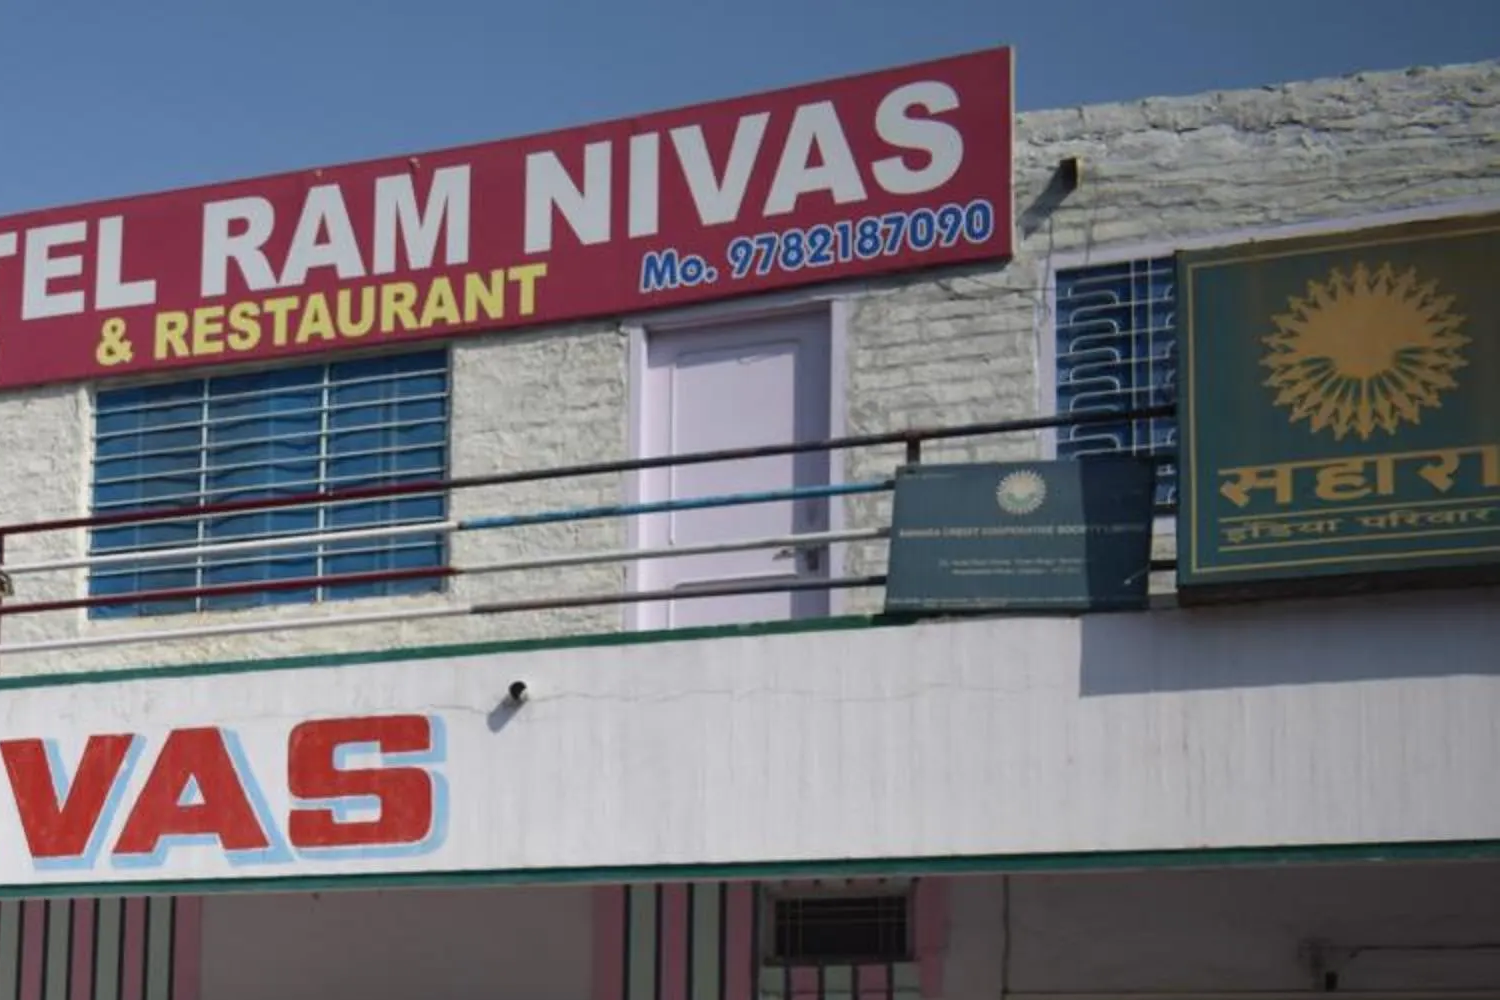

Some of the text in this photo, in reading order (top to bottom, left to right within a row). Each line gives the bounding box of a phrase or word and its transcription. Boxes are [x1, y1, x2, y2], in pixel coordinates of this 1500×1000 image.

[199, 164, 472, 298] RAM
[523, 79, 965, 255] NIVAS
[640, 199, 994, 293] Mo. 9782187090
[95, 262, 548, 365] & RESTAURANT
